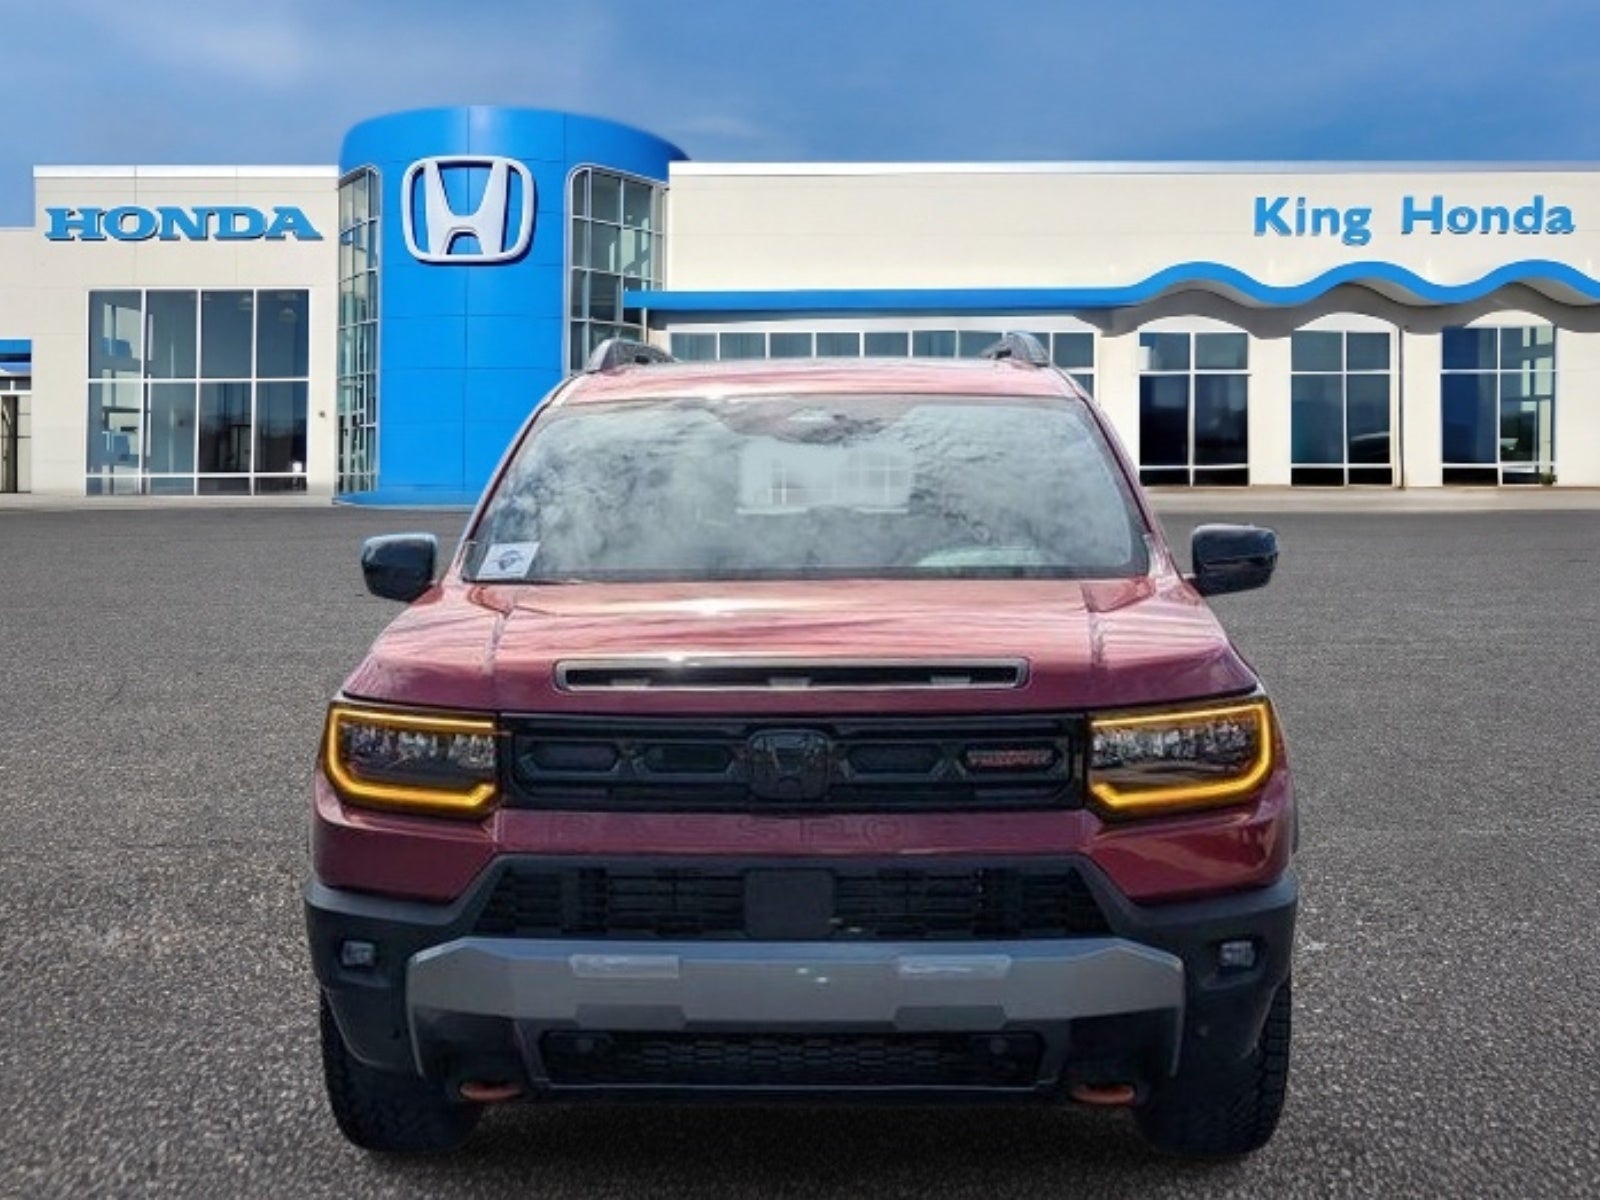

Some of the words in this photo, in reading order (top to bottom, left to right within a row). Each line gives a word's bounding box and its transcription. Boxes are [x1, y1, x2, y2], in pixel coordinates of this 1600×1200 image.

[45, 206, 324, 241] HONDA
[1254, 196, 1372, 246] King
[1401, 195, 1576, 235] Honda
